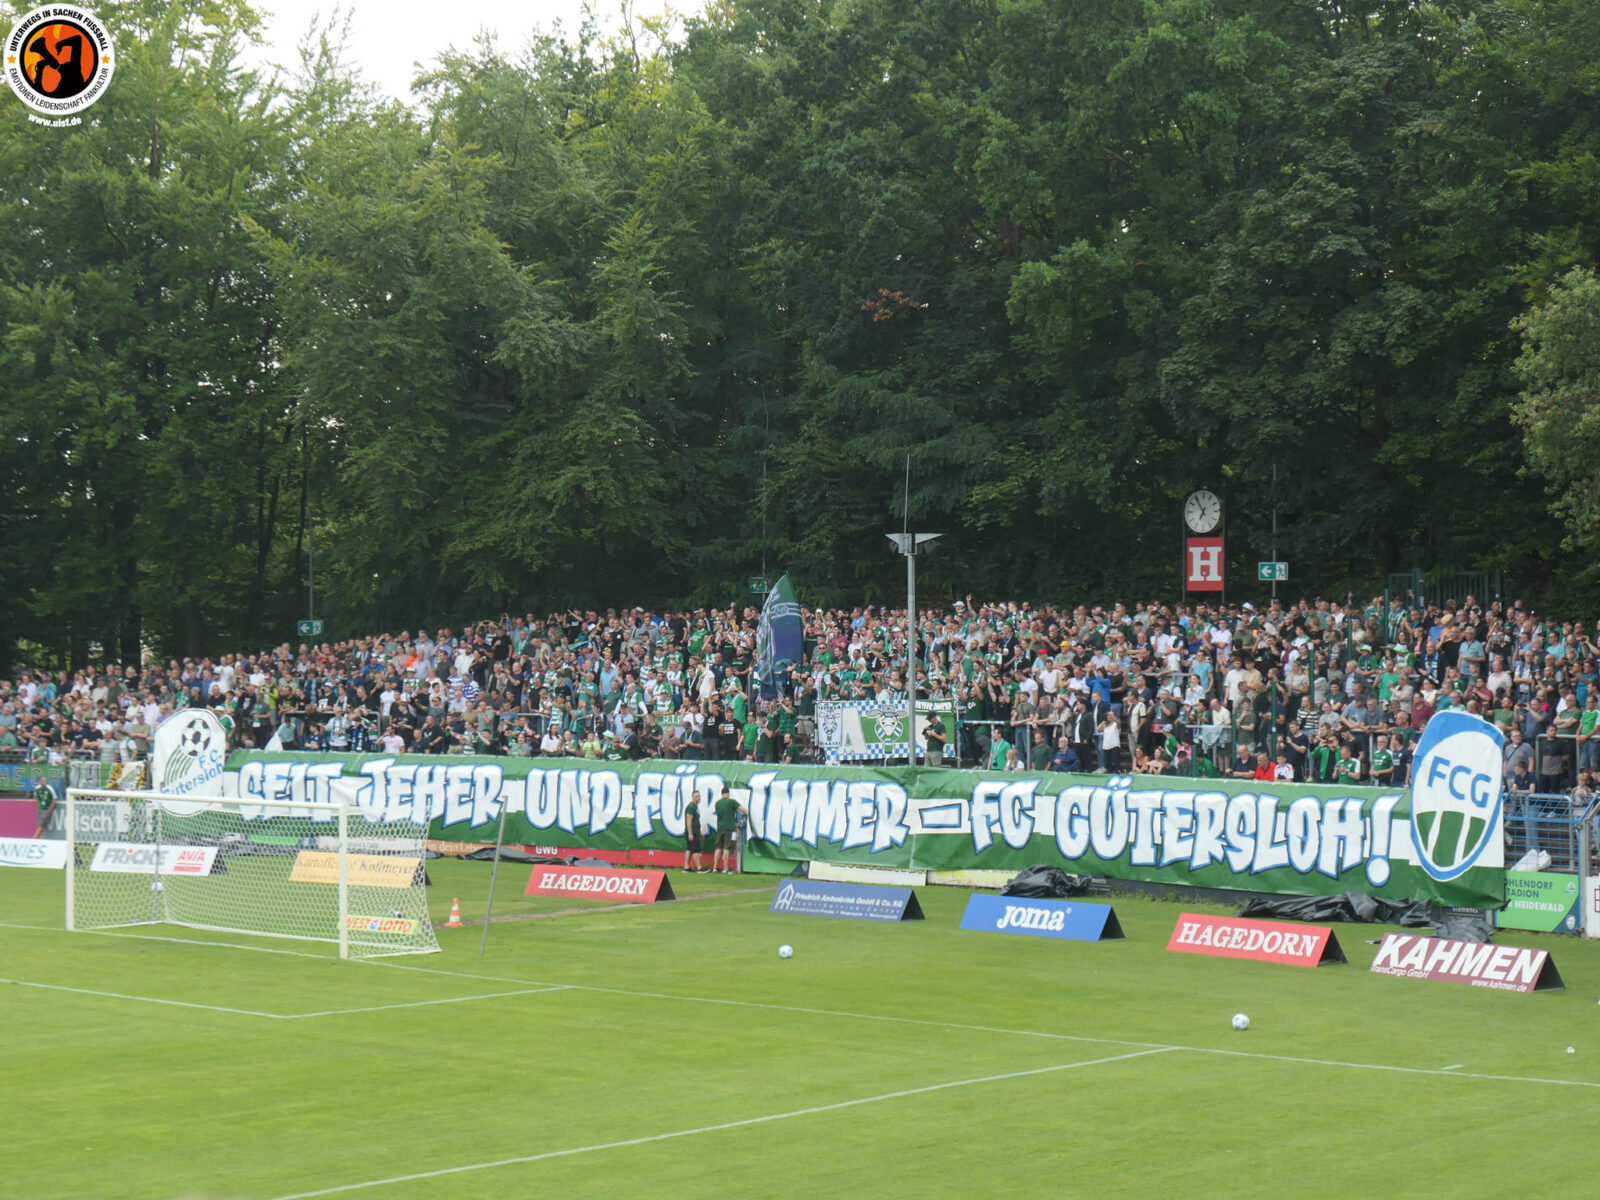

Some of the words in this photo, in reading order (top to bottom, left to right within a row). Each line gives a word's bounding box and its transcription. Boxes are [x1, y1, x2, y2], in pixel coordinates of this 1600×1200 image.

[1428, 755, 1492, 808] FCG
[238, 761, 346, 823] SEIT
[356, 756, 505, 829] JEHER
[525, 766, 622, 835] UND
[634, 764, 726, 840] FÜR
[747, 769, 911, 853] IMMER
[969, 778, 1043, 854] FC
[1054, 774, 1404, 887] GÜTERSLOH!
[538, 872, 649, 895] HAGEDORN
[1506, 888, 1540, 898] TADION
[856, 896, 875, 906] GmbH
[881, 899, 891, 907] Co.
[1515, 900, 1565, 913] HEIDEWALD
[377, 919, 412, 933] LOTTO
[1176, 921, 1320, 958] HAGEDORN
[1372, 934, 1549, 983] KAHMEN
[1369, 964, 1406, 977] TransCargo
[1407, 968, 1430, 979] GmbH
[1471, 979, 1528, 993] www.kahmen.de
